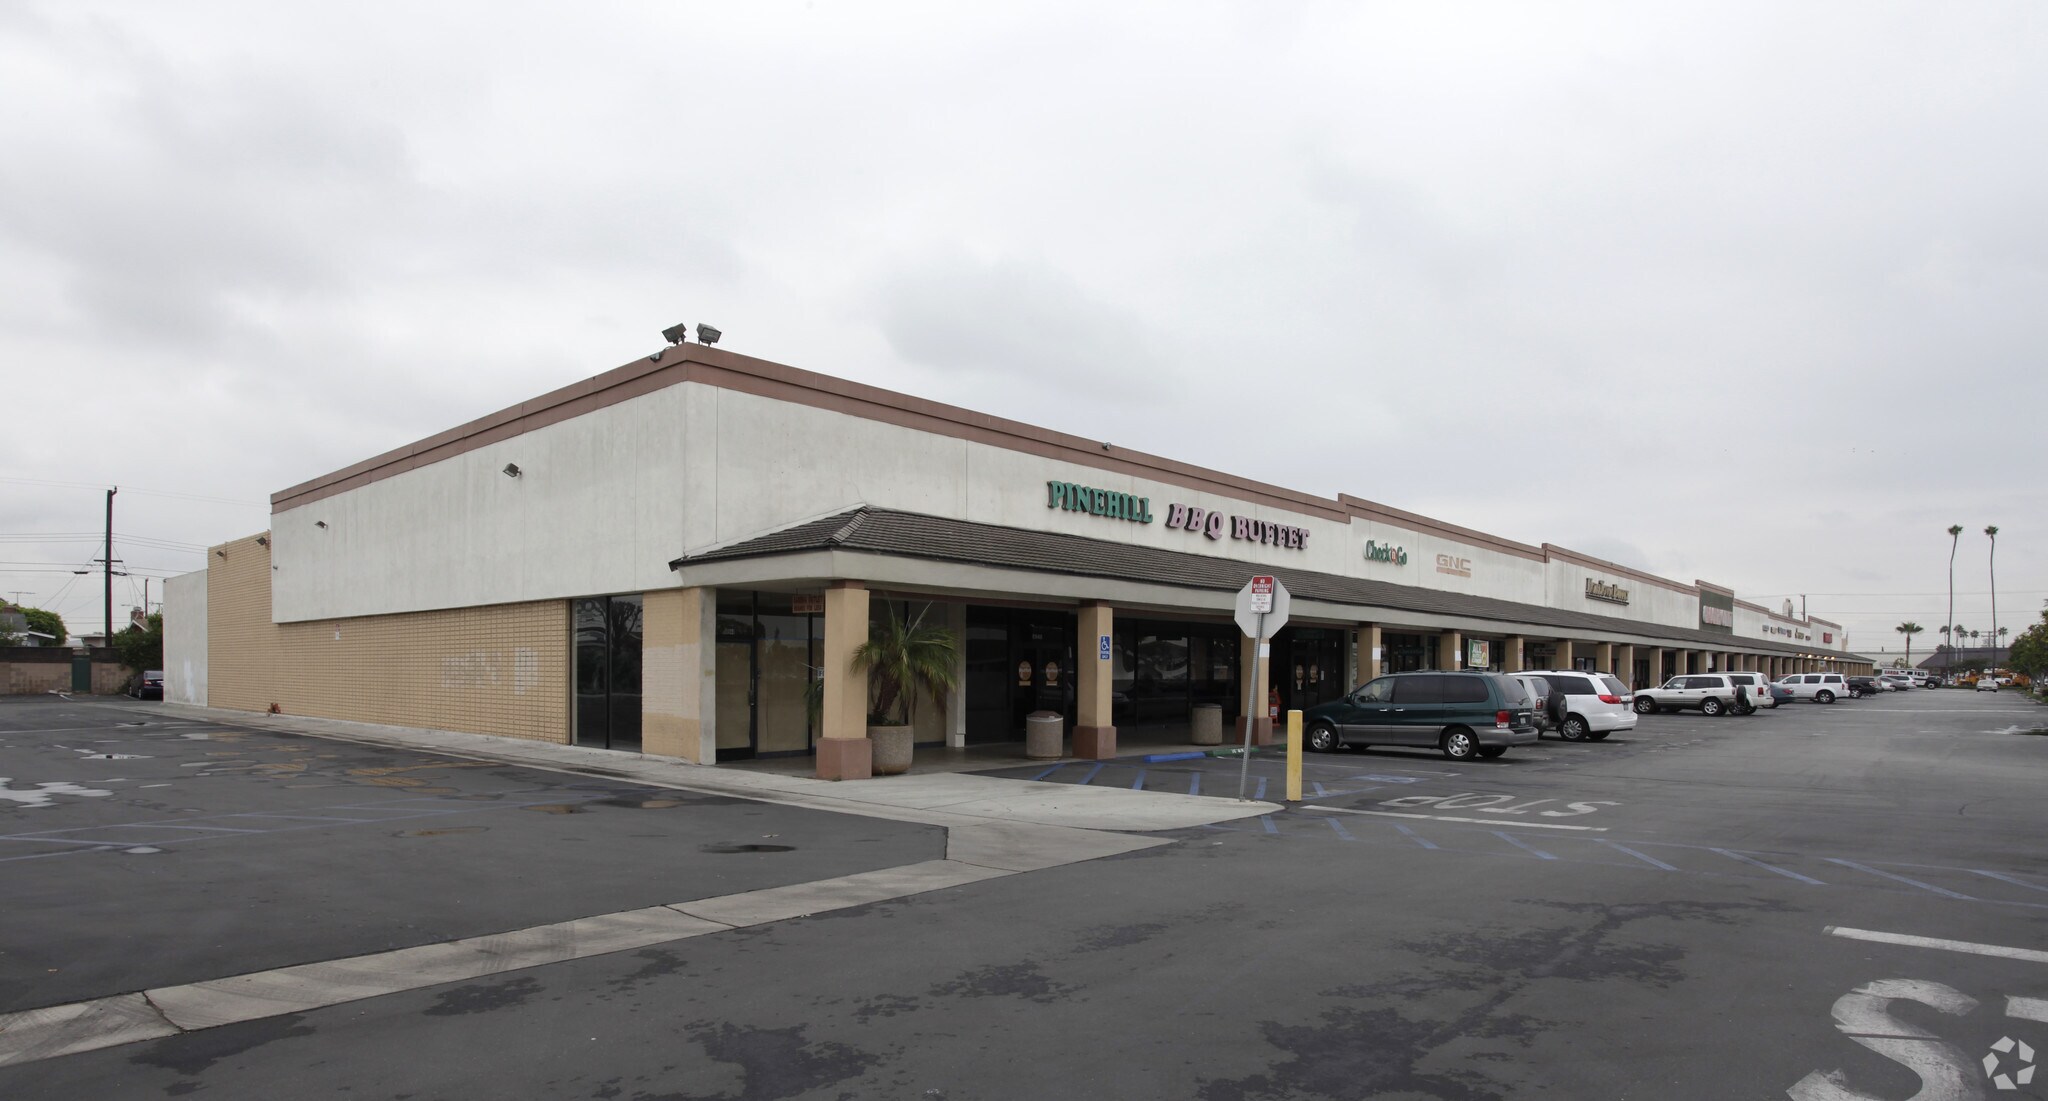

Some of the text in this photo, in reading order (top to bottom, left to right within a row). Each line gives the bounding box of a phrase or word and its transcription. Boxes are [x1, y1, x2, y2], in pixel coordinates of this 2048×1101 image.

[1047, 480, 1310, 549] PINEHILL BBQ BUFFET
[1436, 554, 1471, 571] GNC
[1377, 792, 1622, 816] STOP
